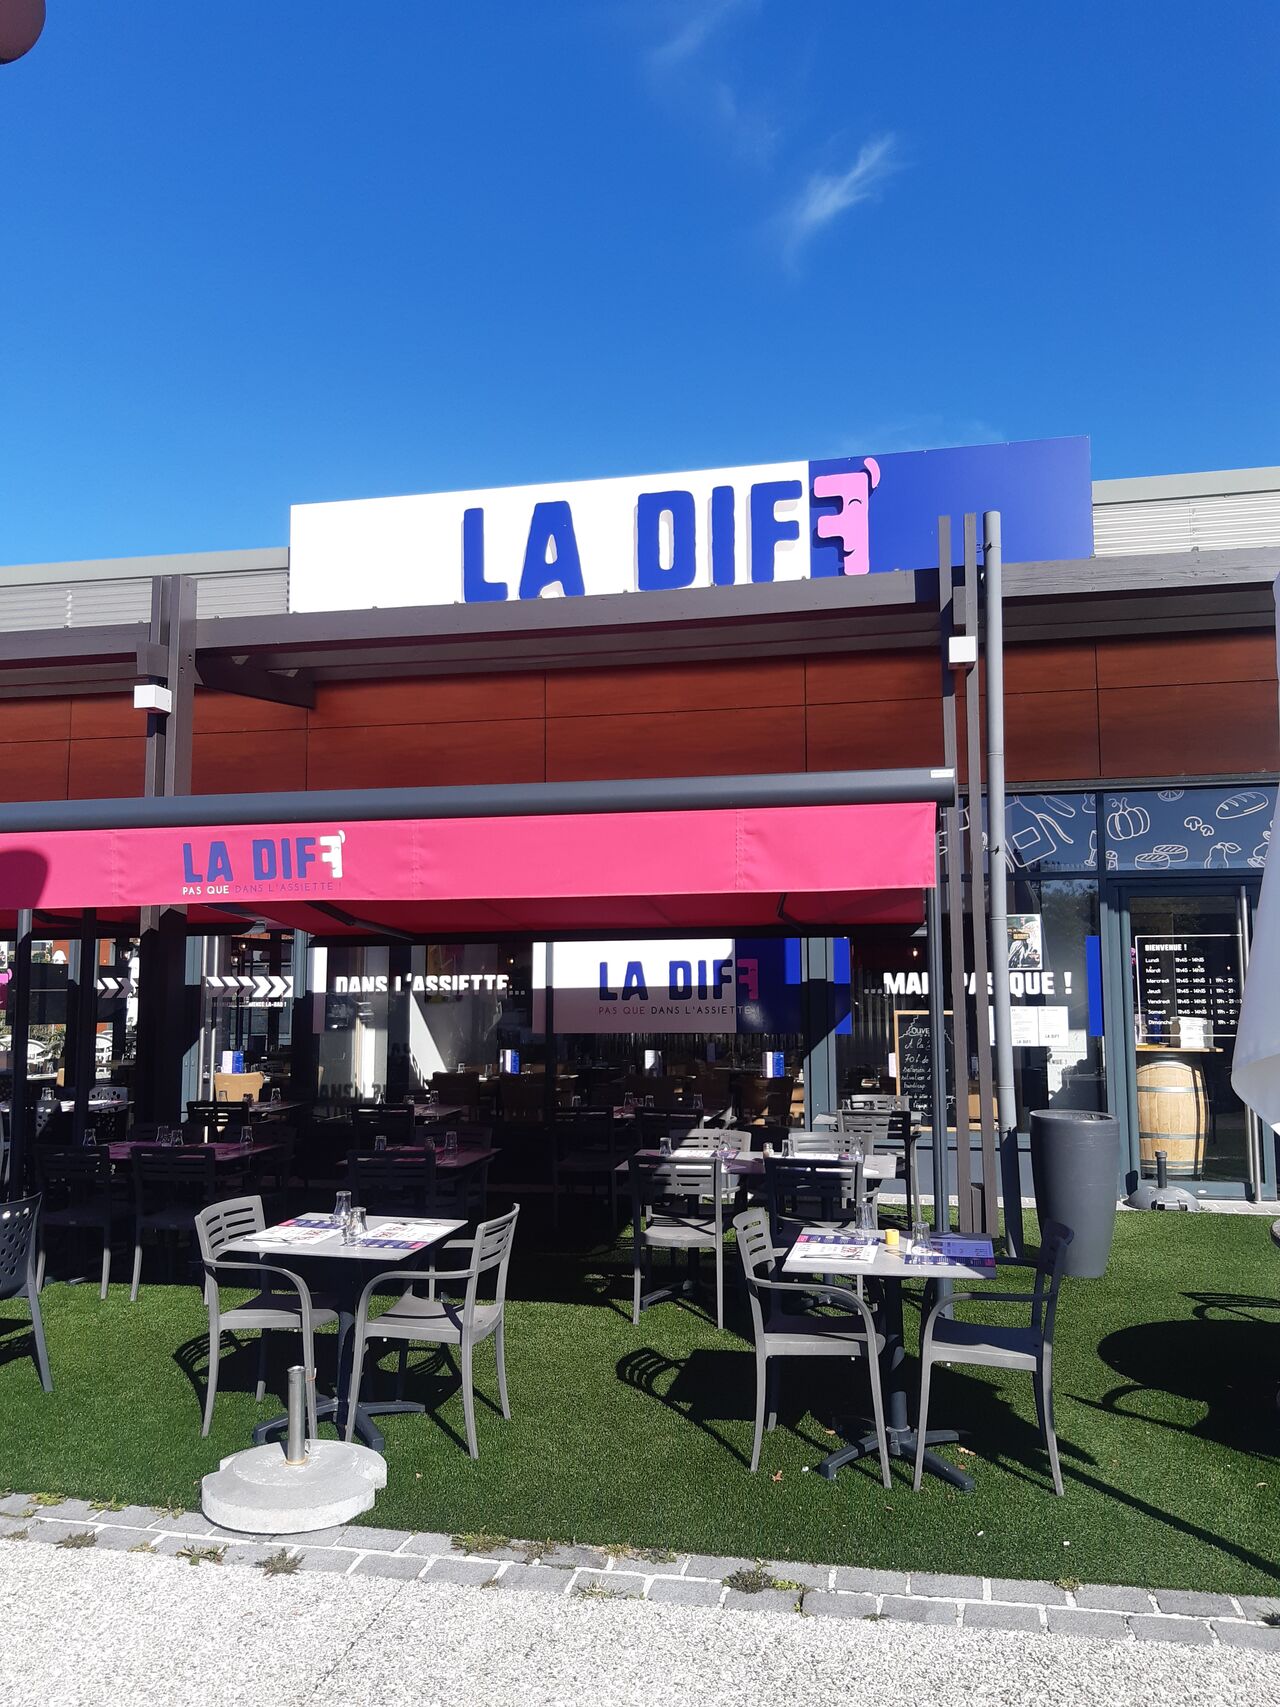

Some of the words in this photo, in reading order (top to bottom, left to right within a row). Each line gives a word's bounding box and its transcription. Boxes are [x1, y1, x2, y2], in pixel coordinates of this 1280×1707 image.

[463, 500, 585, 603] LA
[637, 458, 881, 592] DIFF
[183, 841, 233, 883] LA
[252, 830, 346, 880] DIFF
[182, 886, 202, 895] PAS
[207, 885, 229, 894] QUE
[235, 885, 263, 893] DANS
[268, 882, 334, 892] L'ASSIETTE
[335, 976, 388, 996] DANS
[599, 961, 649, 1000] LA
[668, 958, 759, 1000] DIFF
[1009, 972, 1055, 997] QUE
[1064, 972, 1073, 994] !
[599, 1006, 617, 1015] PAS
[623, 1006, 645, 1014] QUE
[651, 1006, 680, 1014] DANS
[685, 1005, 752, 1014] L'ASSIETTE
